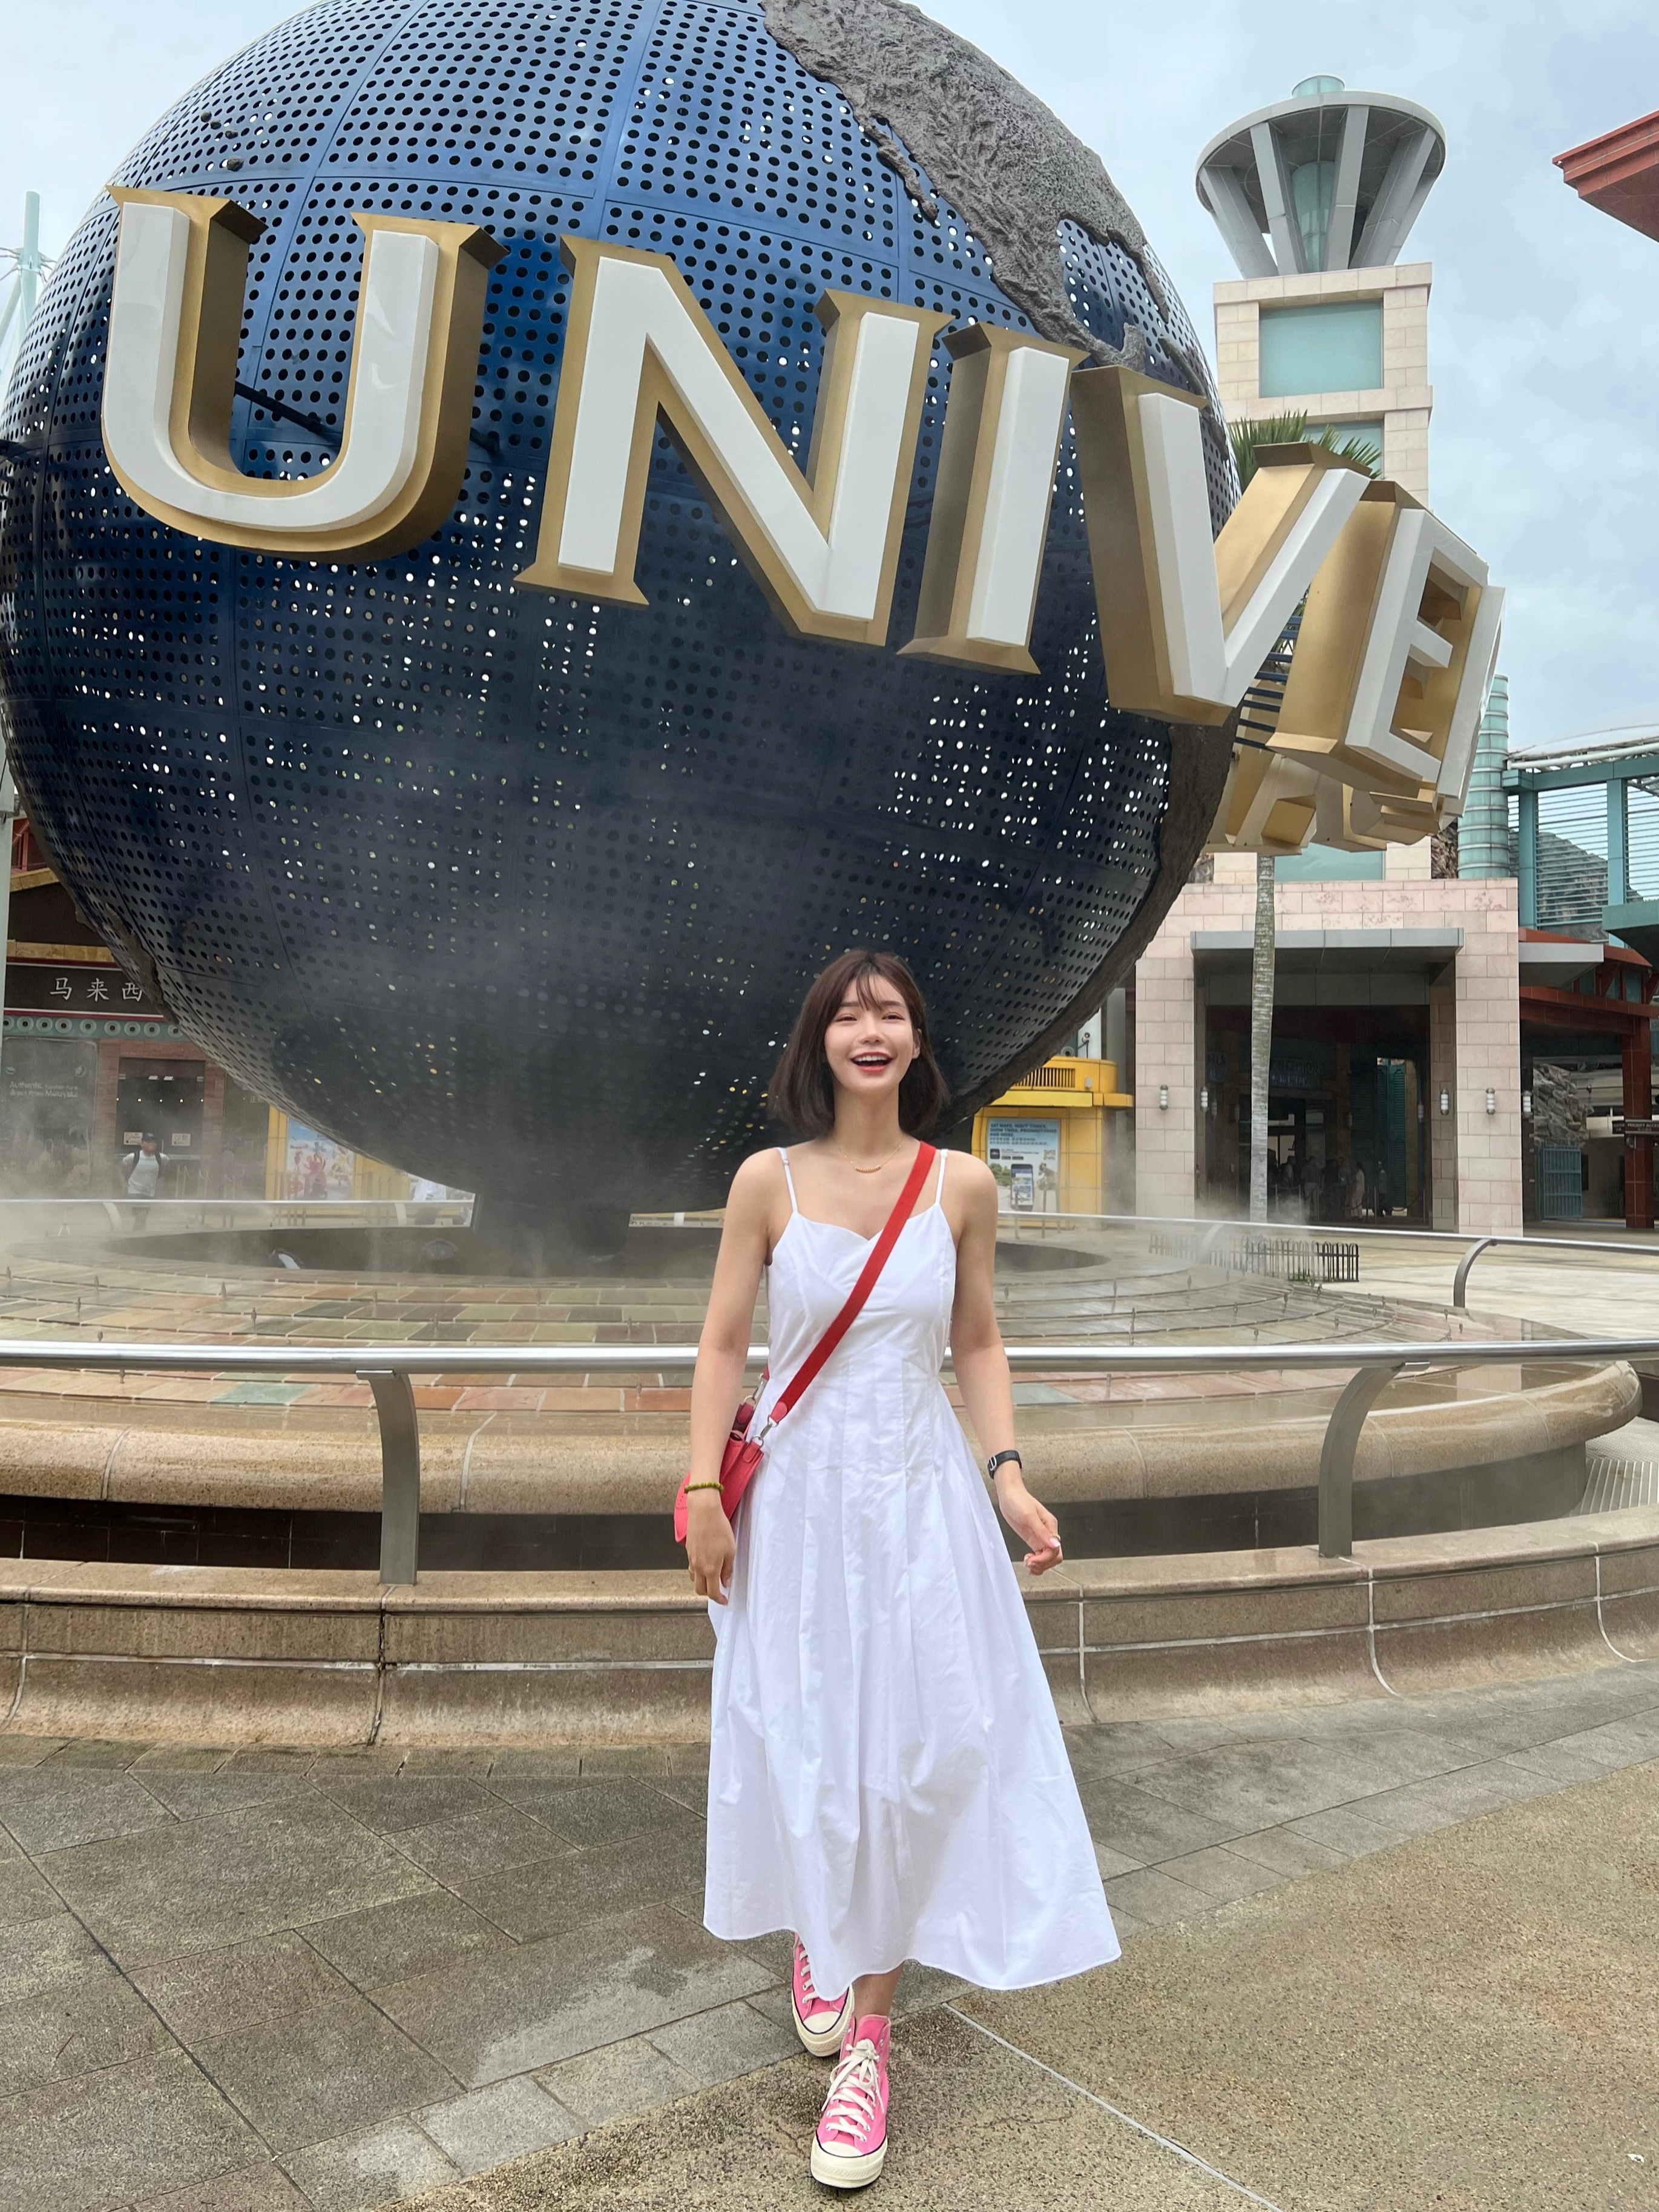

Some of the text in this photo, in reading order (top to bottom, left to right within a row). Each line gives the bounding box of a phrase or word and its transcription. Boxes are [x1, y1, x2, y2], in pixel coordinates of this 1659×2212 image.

[100, 184, 1506, 817] UNIVE
[50, 977, 143, 1002] 马来西
